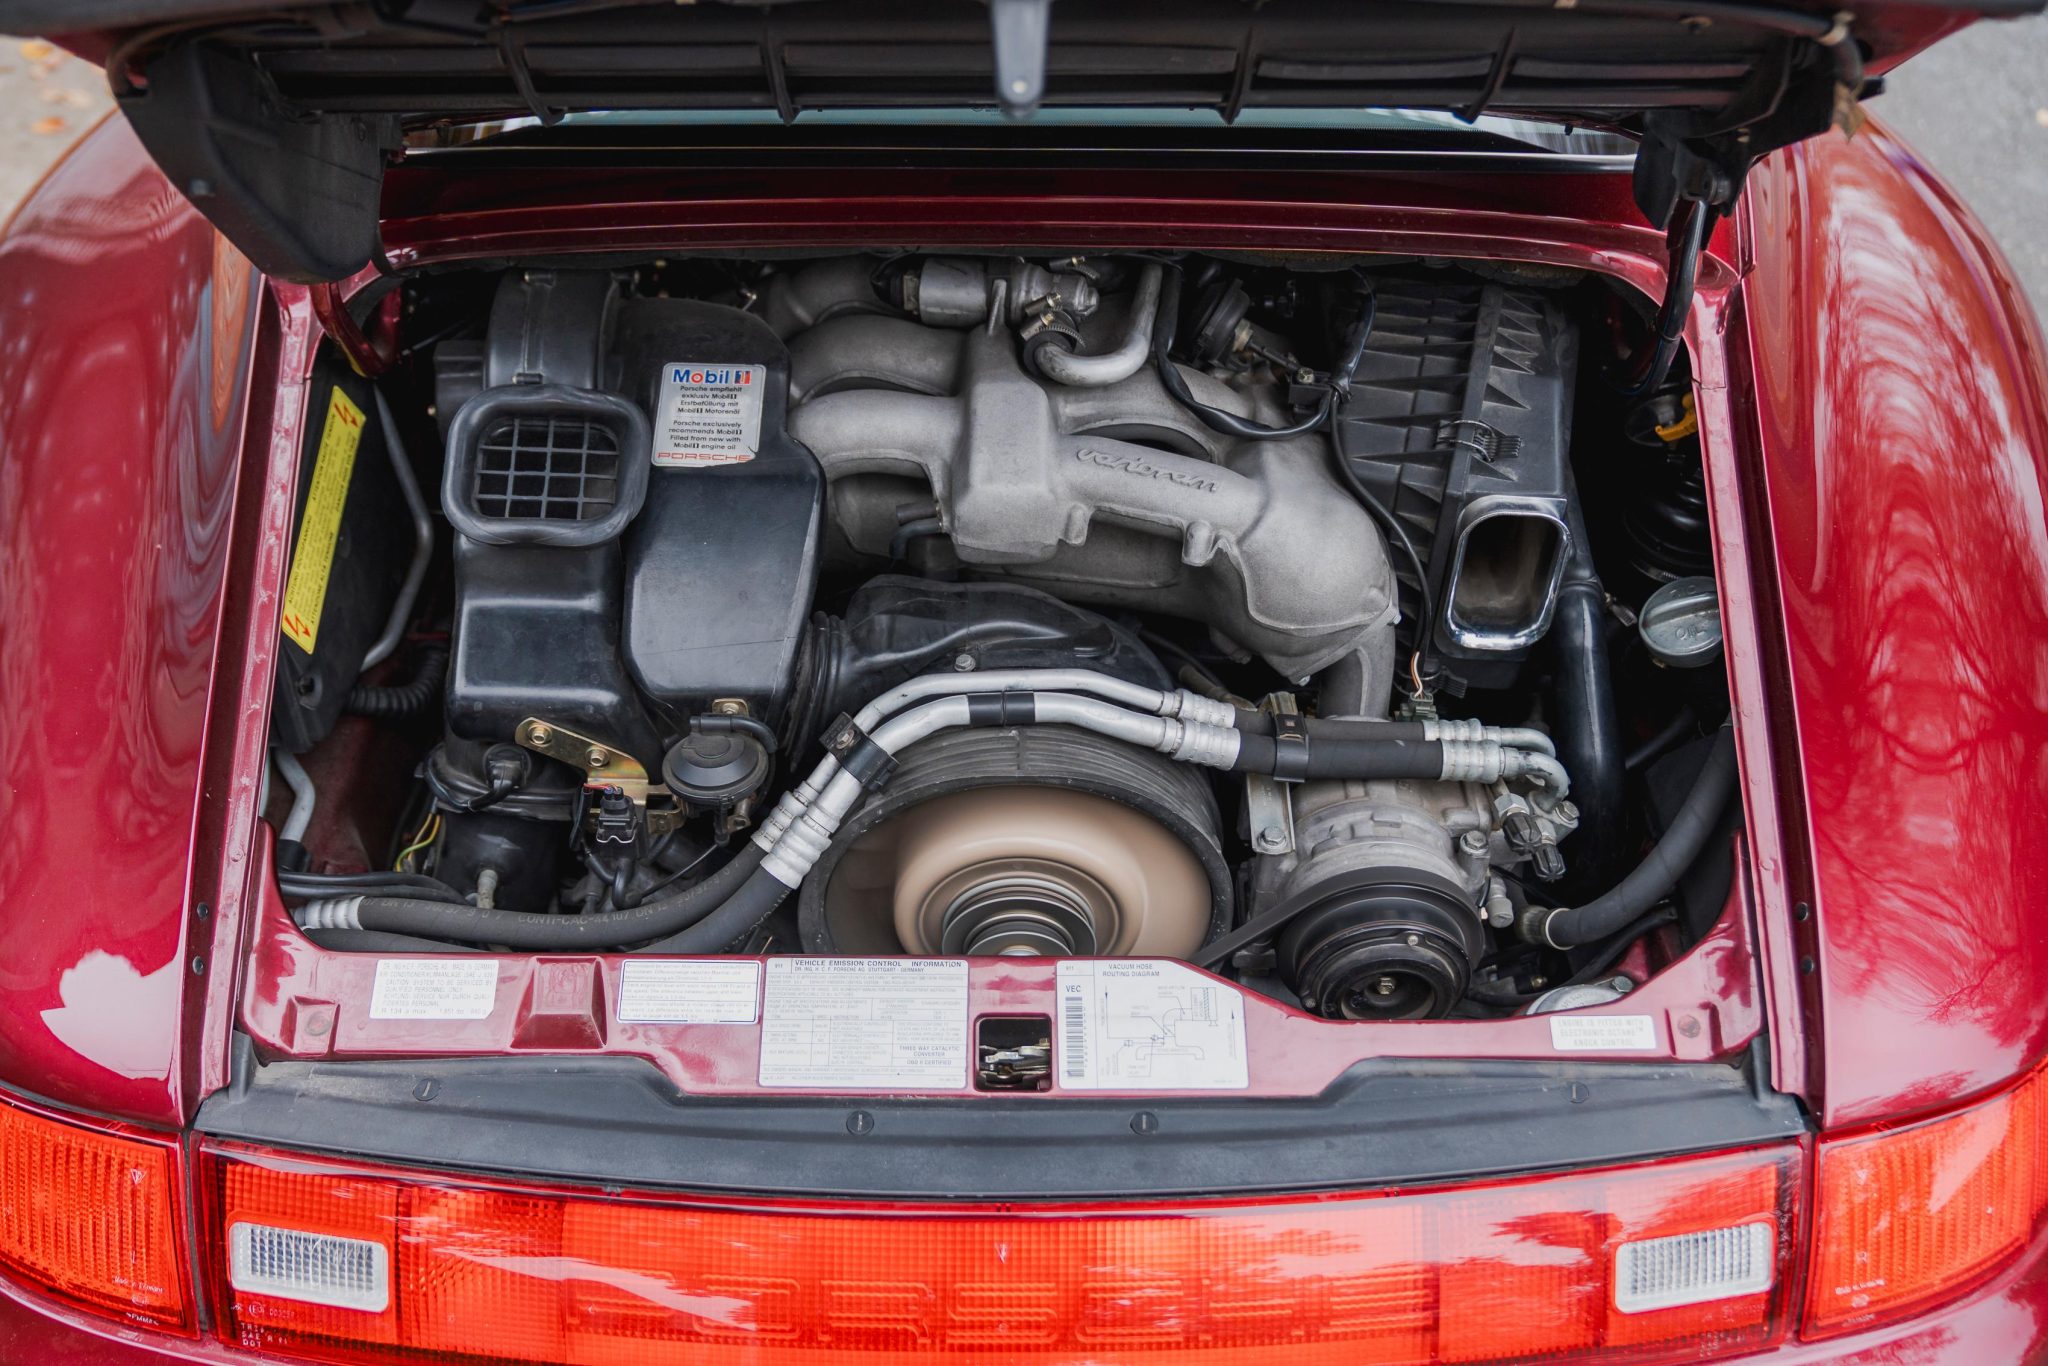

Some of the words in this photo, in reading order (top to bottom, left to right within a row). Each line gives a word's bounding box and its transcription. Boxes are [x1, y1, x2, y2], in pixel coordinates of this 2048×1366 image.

[673, 369, 729, 383] Mobil
[657, 452, 752, 462] PORSCHE
[565, 1270, 1436, 1343] PORSCHE
[243, 1338, 261, 1348] DOT
